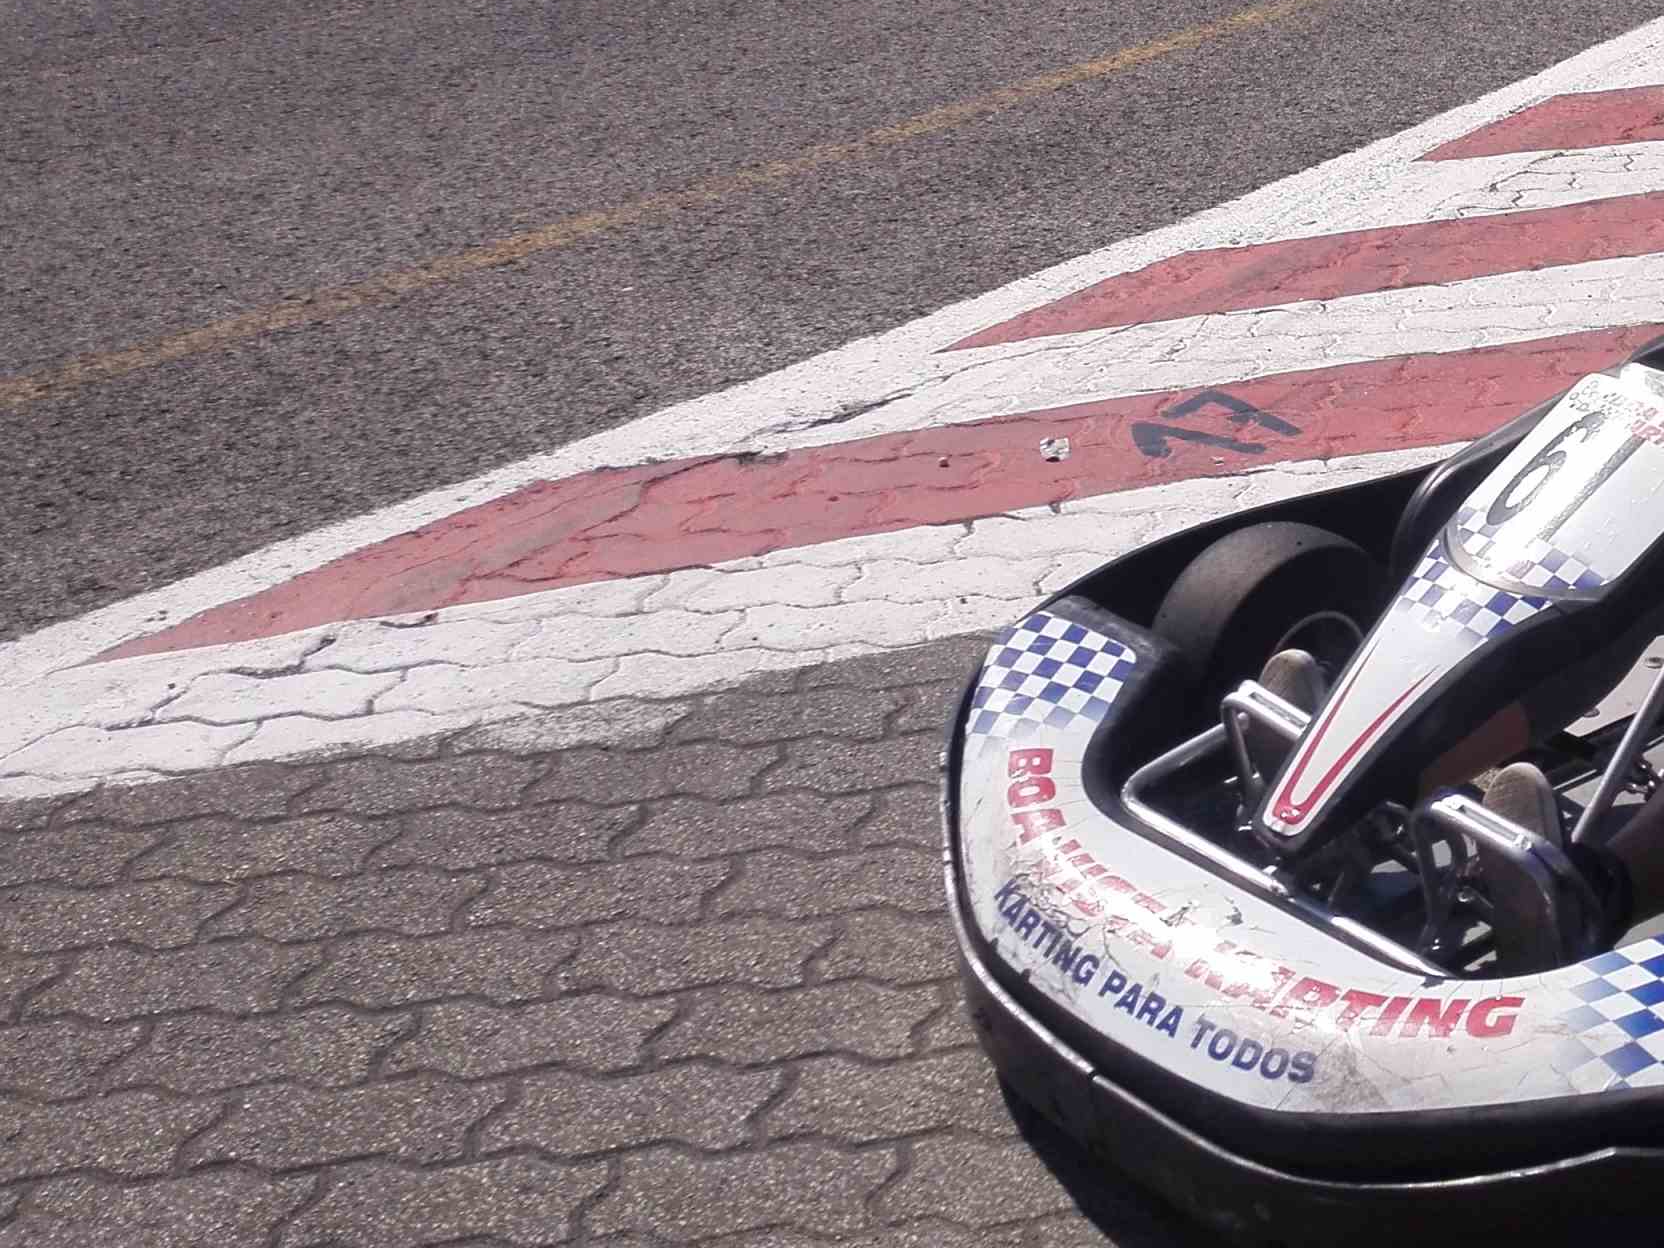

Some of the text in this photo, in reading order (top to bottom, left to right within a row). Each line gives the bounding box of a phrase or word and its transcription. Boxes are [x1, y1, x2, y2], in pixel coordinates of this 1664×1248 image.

[994, 878, 1318, 1084] KARTING PARA TODOS
